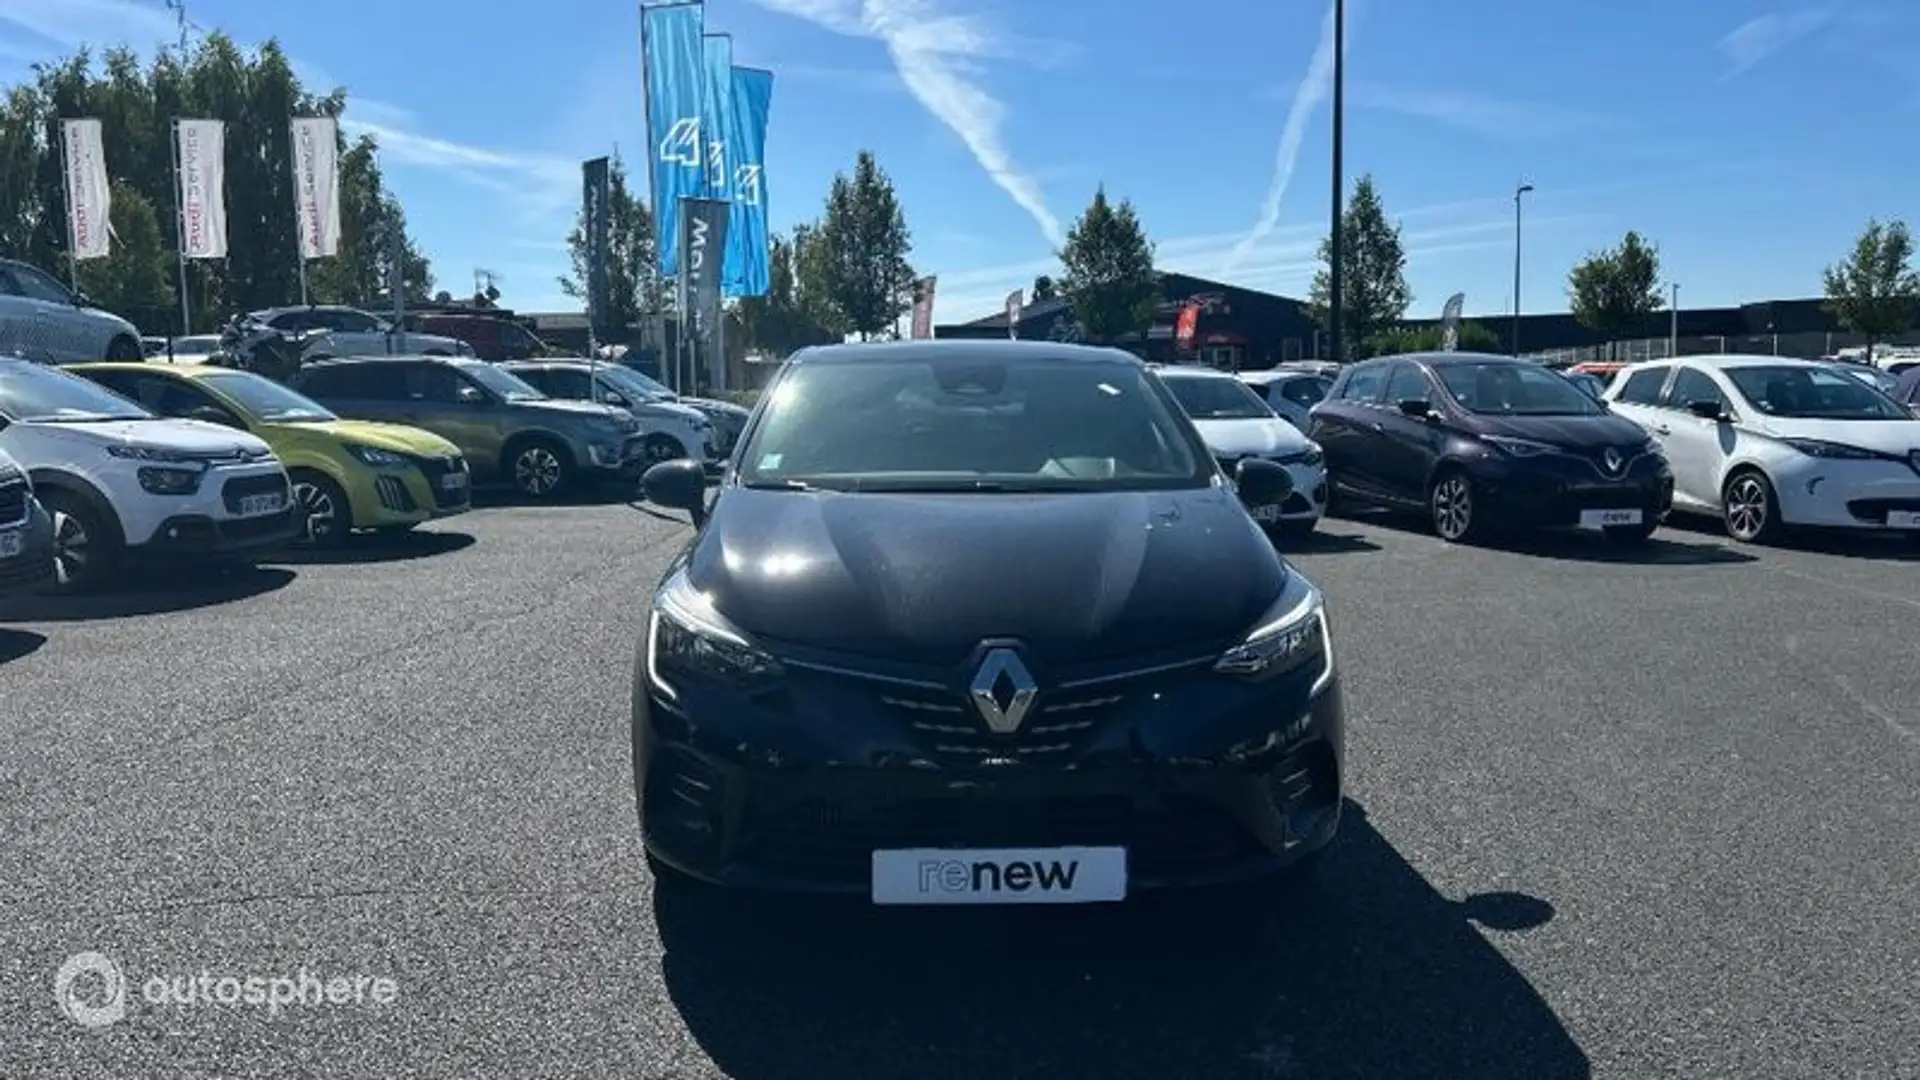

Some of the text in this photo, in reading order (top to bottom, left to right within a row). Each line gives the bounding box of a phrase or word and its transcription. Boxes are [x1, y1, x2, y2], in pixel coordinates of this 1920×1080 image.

[75, 203, 88, 249] Audi
[185, 127, 201, 249] Audi Service
[301, 125, 320, 248] Audi Service
[918, 859, 1078, 892] renew
